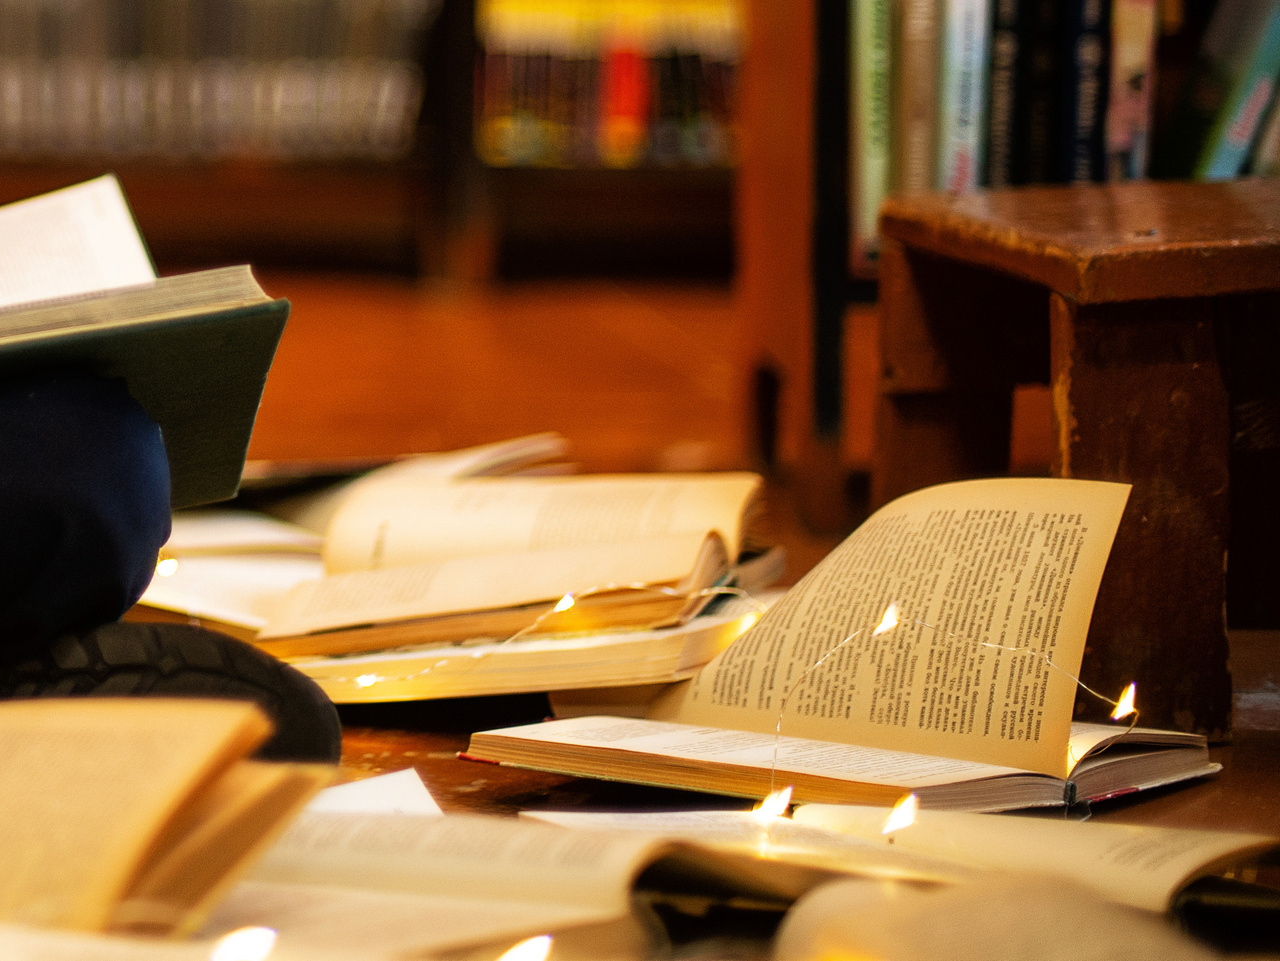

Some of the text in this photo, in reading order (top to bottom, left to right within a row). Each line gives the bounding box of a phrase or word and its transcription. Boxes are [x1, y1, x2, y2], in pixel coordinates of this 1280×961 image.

[1026, 531, 1035, 547] июля
[1041, 521, 1056, 546] мировой
[1047, 531, 1060, 555] двухсот
[1054, 528, 1069, 561] страницах
[1020, 550, 1030, 566] 1857
[1057, 556, 1069, 578] одного
[1067, 536, 1085, 574] «Дневнике»
[1012, 569, 1023, 585] года,
[1027, 552, 1045, 591] литературы,
[1033, 563, 1050, 602] упоминаний
[1008, 588, 1017, 601] уже
[1040, 568, 1058, 609] «Дневника»,
[1056, 577, 1071, 612] отразился
[981, 599, 989, 612] всю
[1023, 594, 1031, 611] имен
[965, 604, 980, 638] достойной
[1022, 610, 1036, 647] различных
[1032, 616, 1043, 638] между
[1038, 591, 1059, 652] образованнейших
[1048, 615, 1062, 646] широкий
[896, 629, 907, 649] серой
[970, 624, 982, 653] которую
[926, 648, 934, 669] месяц
[936, 649, 944, 663] Это
[939, 641, 953, 688] путешествии,
[955, 641, 969, 692] сопутствовать
[966, 657, 974, 671] уже
[991, 659, 1000, 679] своем
[1033, 656, 1044, 678] людей
[906, 655, 918, 686] Прихожу
[948, 677, 956, 690] Что
[973, 669, 982, 686] моей
[1004, 656, 1017, 698] художников
[1011, 655, 1027, 704] произведений
[963, 675, 971, 696] давно
[1029, 682, 1038, 705] своего
[1037, 670, 1049, 706] интересов
[892, 692, 902, 725] сапогами
[899, 700, 909, 727] ротную
[918, 706, 926, 728] какой-
[957, 700, 968, 733] упаковал
[965, 690, 978, 734] библиотеки,
[981, 682, 997, 736] освобождении,
[1017, 685, 1029, 722] встречаем
[933, 707, 942, 730] плава-
[940, 707, 950, 731] делать
[998, 710, 1008, 737] скульп-
[1006, 710, 1017, 739] русской
[1023, 708, 1034, 741] времени.
[1033, 719, 1041, 743] позна-
